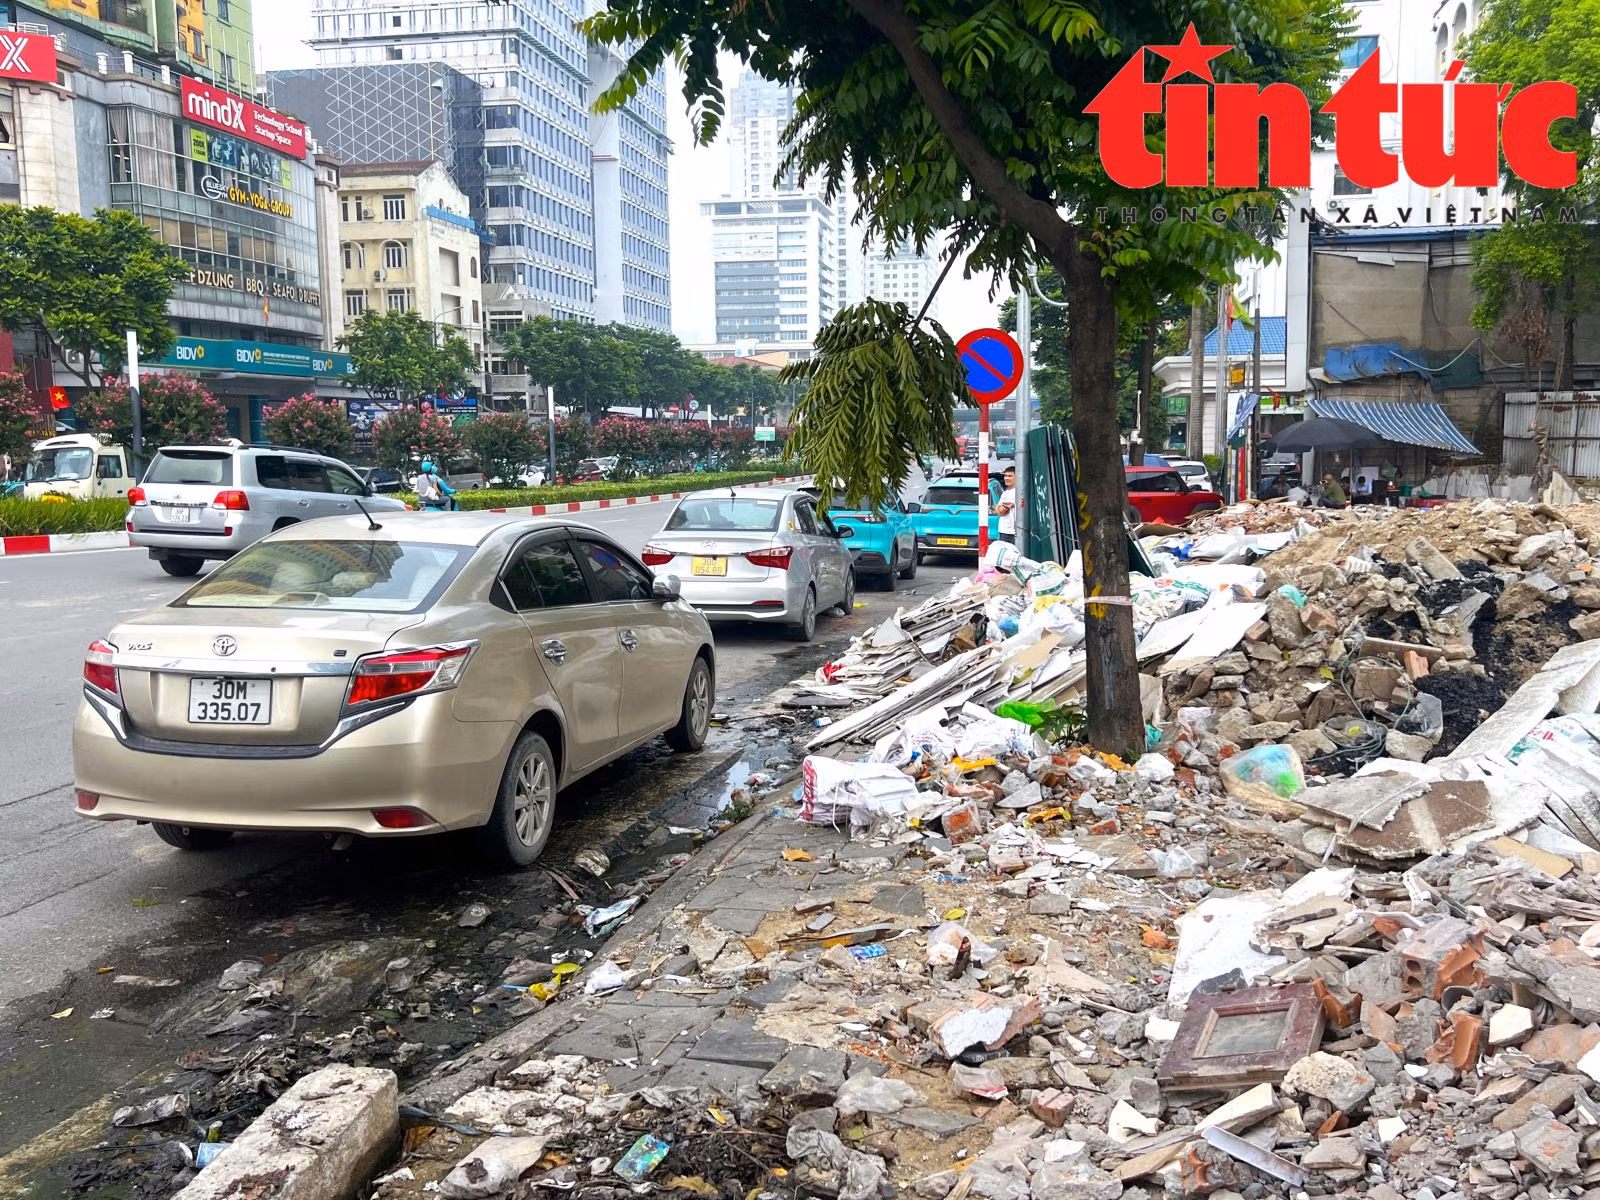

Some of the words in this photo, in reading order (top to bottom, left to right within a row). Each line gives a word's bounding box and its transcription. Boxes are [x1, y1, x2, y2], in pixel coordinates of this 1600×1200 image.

[188, 91, 247, 132] mindX
[253, 110, 285, 132] Technology
[284, 123, 303, 137] School
[254, 124, 276, 142] Startup
[275, 132, 292, 146] Space
[229, 187, 246, 204] GYM
[249, 191, 268, 210] YOGA
[197, 269, 234, 289] DZUNG
[246, 277, 264, 296] BBQ
[176, 345, 197, 360] BIDV
[236, 348, 255, 363] BIDV
[211, 681, 248, 700] 30M
[196, 702, 262, 722] 335.07
